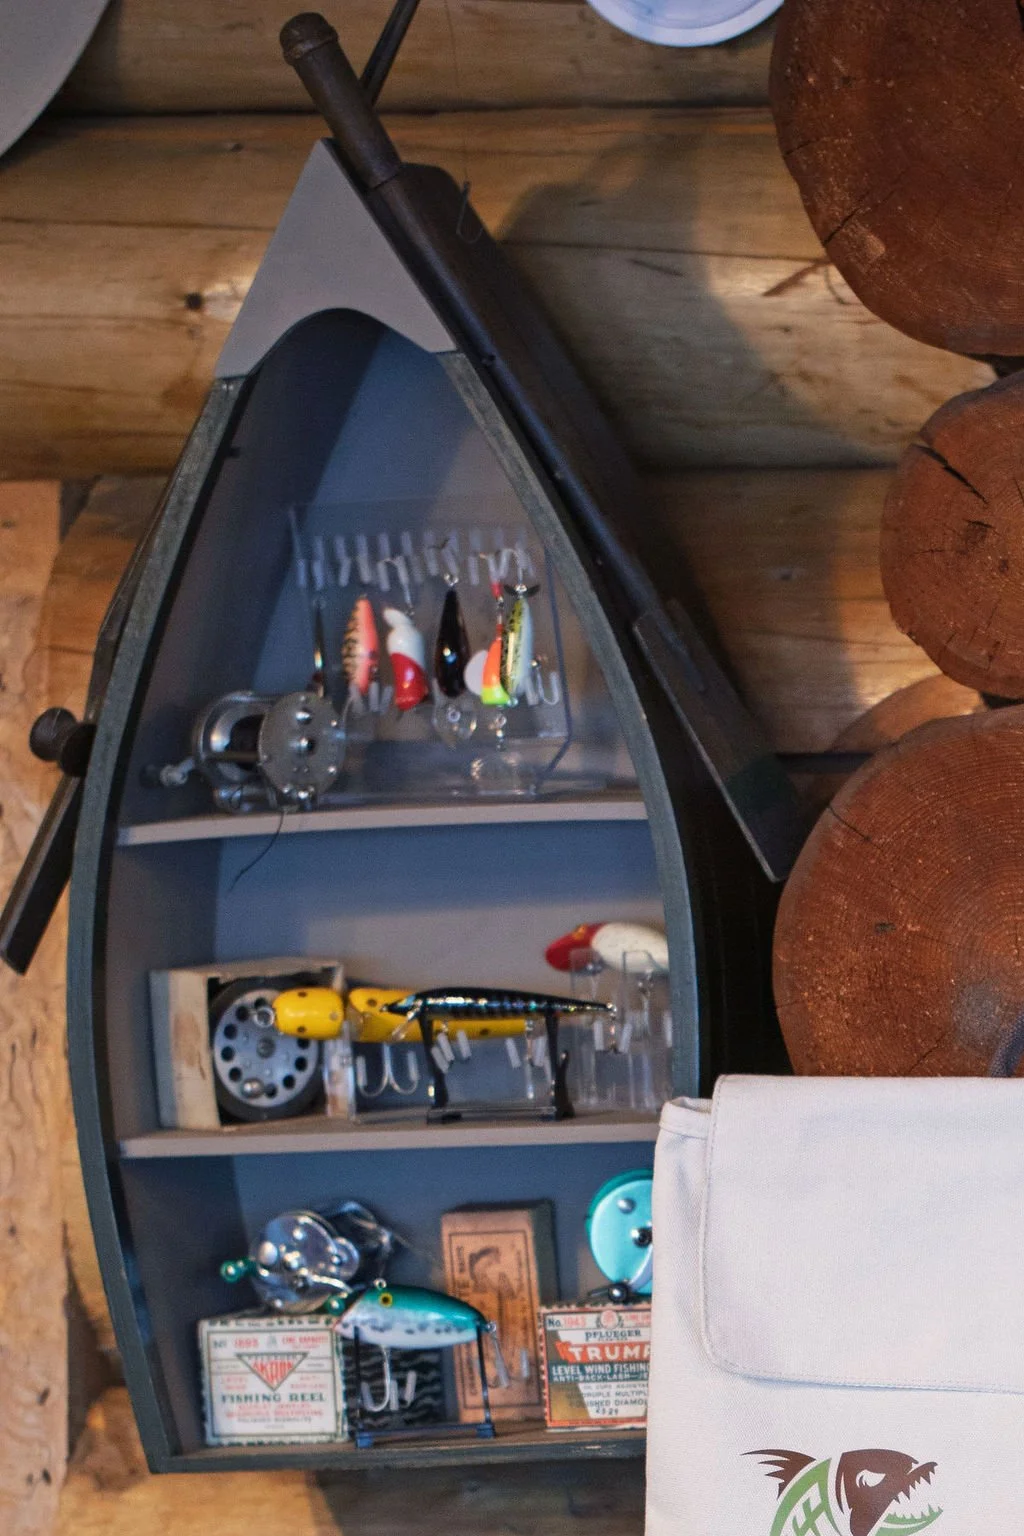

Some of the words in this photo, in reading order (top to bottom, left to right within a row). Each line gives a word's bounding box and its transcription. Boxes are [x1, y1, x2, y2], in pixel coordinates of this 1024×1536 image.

[585, 1329, 642, 1341] PFLUEGER
[552, 1364, 582, 1376] LEVEL
[584, 1363, 612, 1374] WIND
[221, 1393, 282, 1404] FISHING
[288, 1392, 326, 1403] REEL
